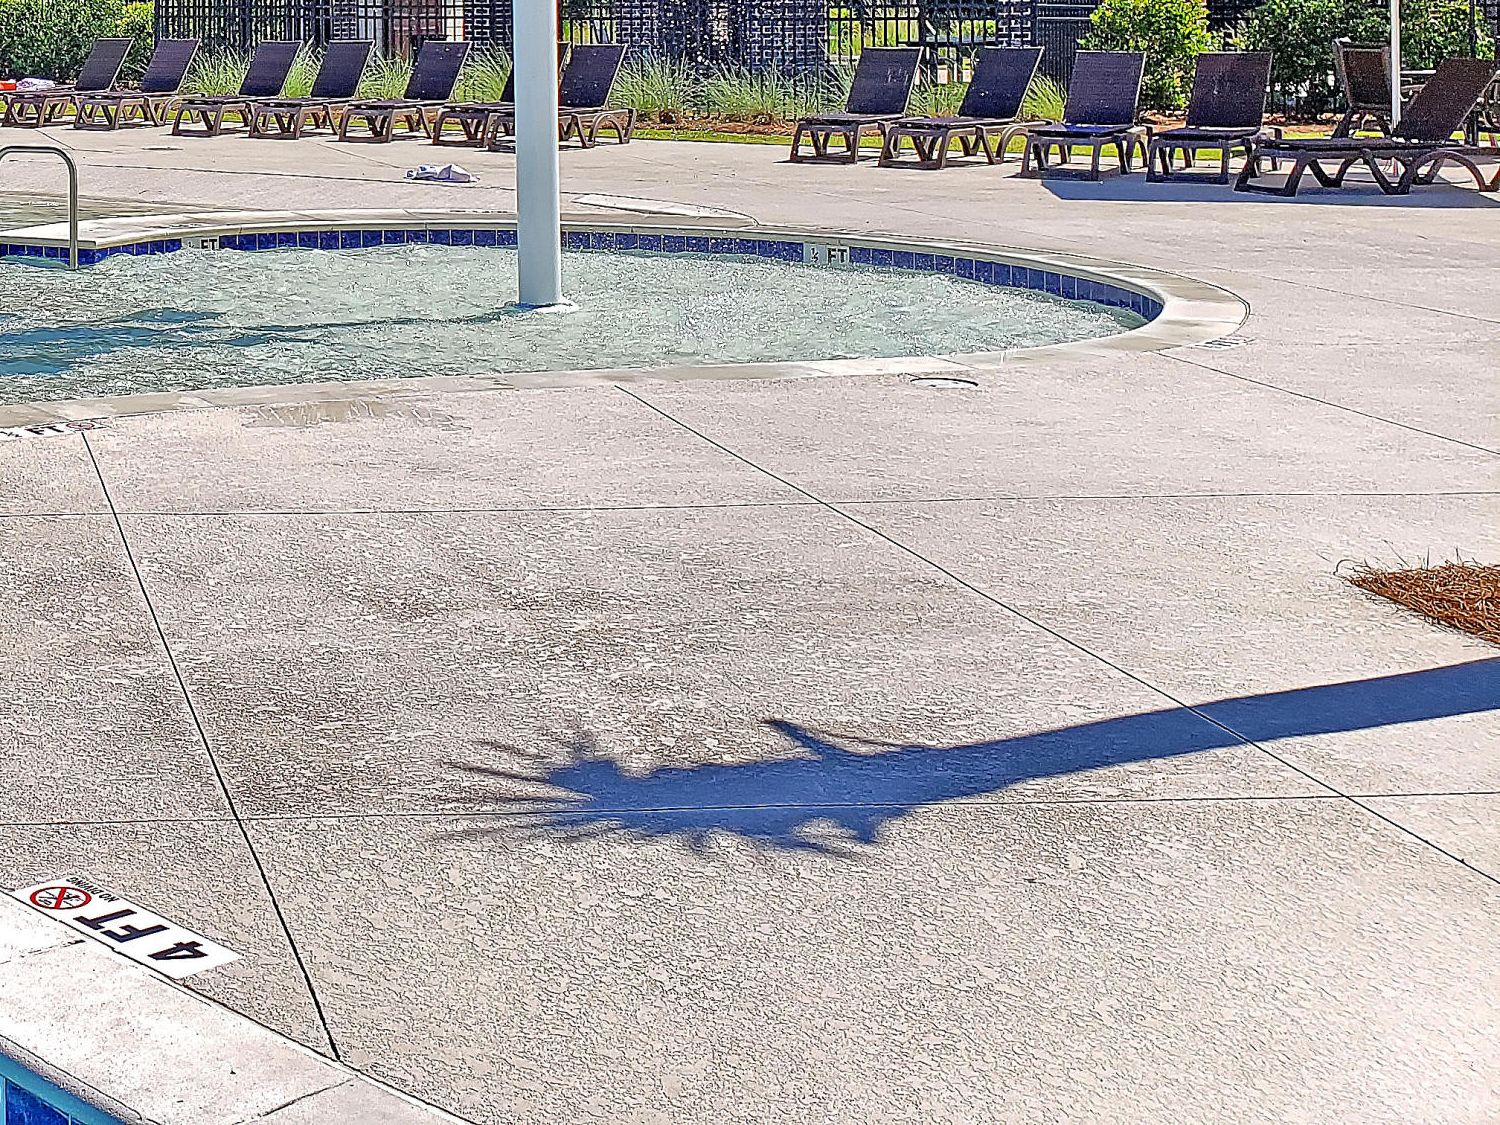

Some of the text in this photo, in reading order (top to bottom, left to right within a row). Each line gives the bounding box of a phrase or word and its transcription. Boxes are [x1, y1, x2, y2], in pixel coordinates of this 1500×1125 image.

[827, 247, 848, 265] FT
[24, 425, 65, 435] FT
[99, 893, 120, 902] NO
[73, 909, 209, 961] 4 FT
